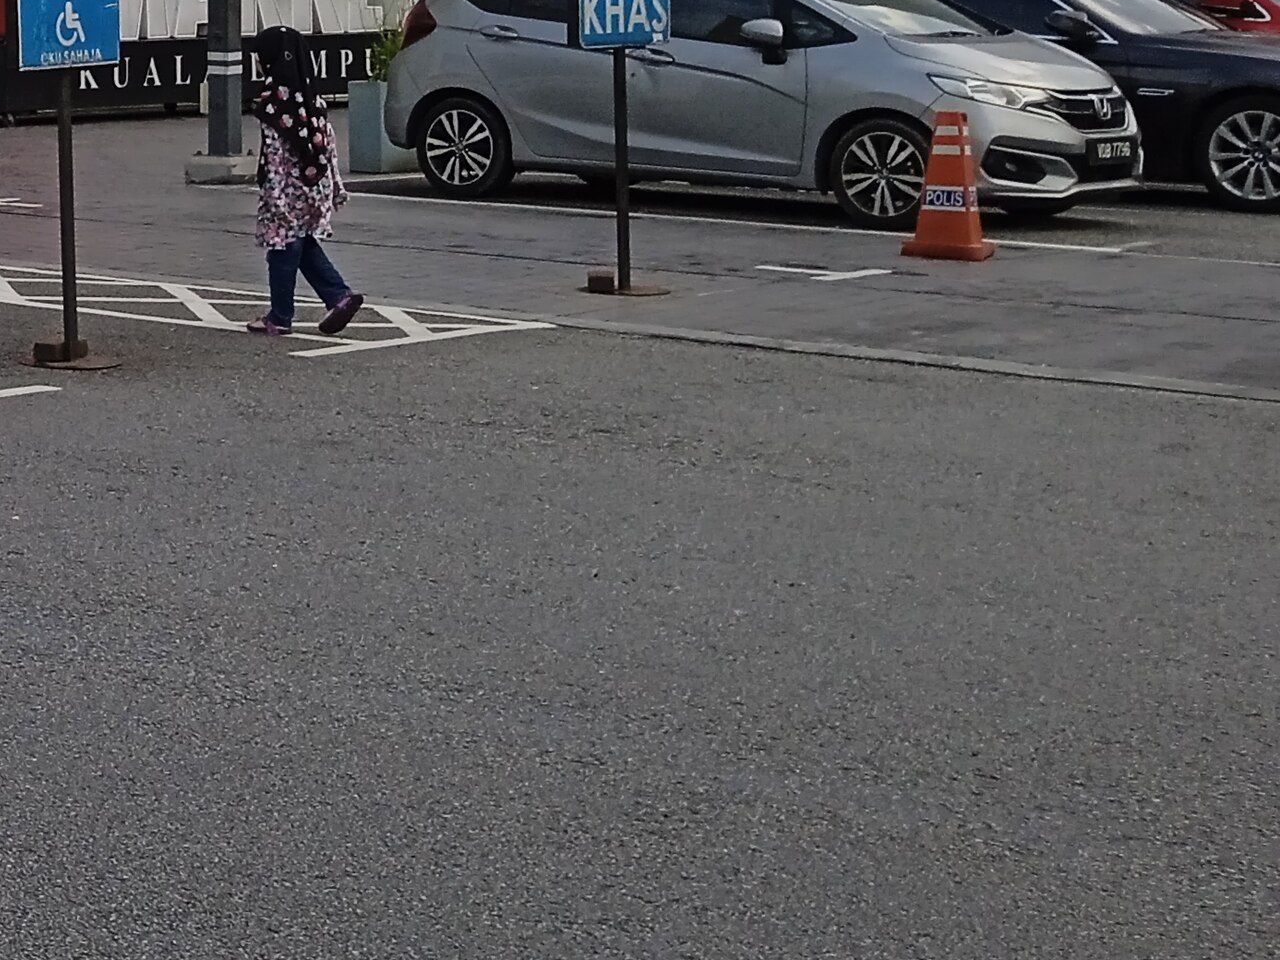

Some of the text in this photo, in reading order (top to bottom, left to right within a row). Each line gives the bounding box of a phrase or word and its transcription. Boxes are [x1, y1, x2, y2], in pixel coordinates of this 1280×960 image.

[63, 48, 102, 64] SAHAJA
[79, 55, 208, 89] KUAL
[926, 190, 964, 206] POLIS
